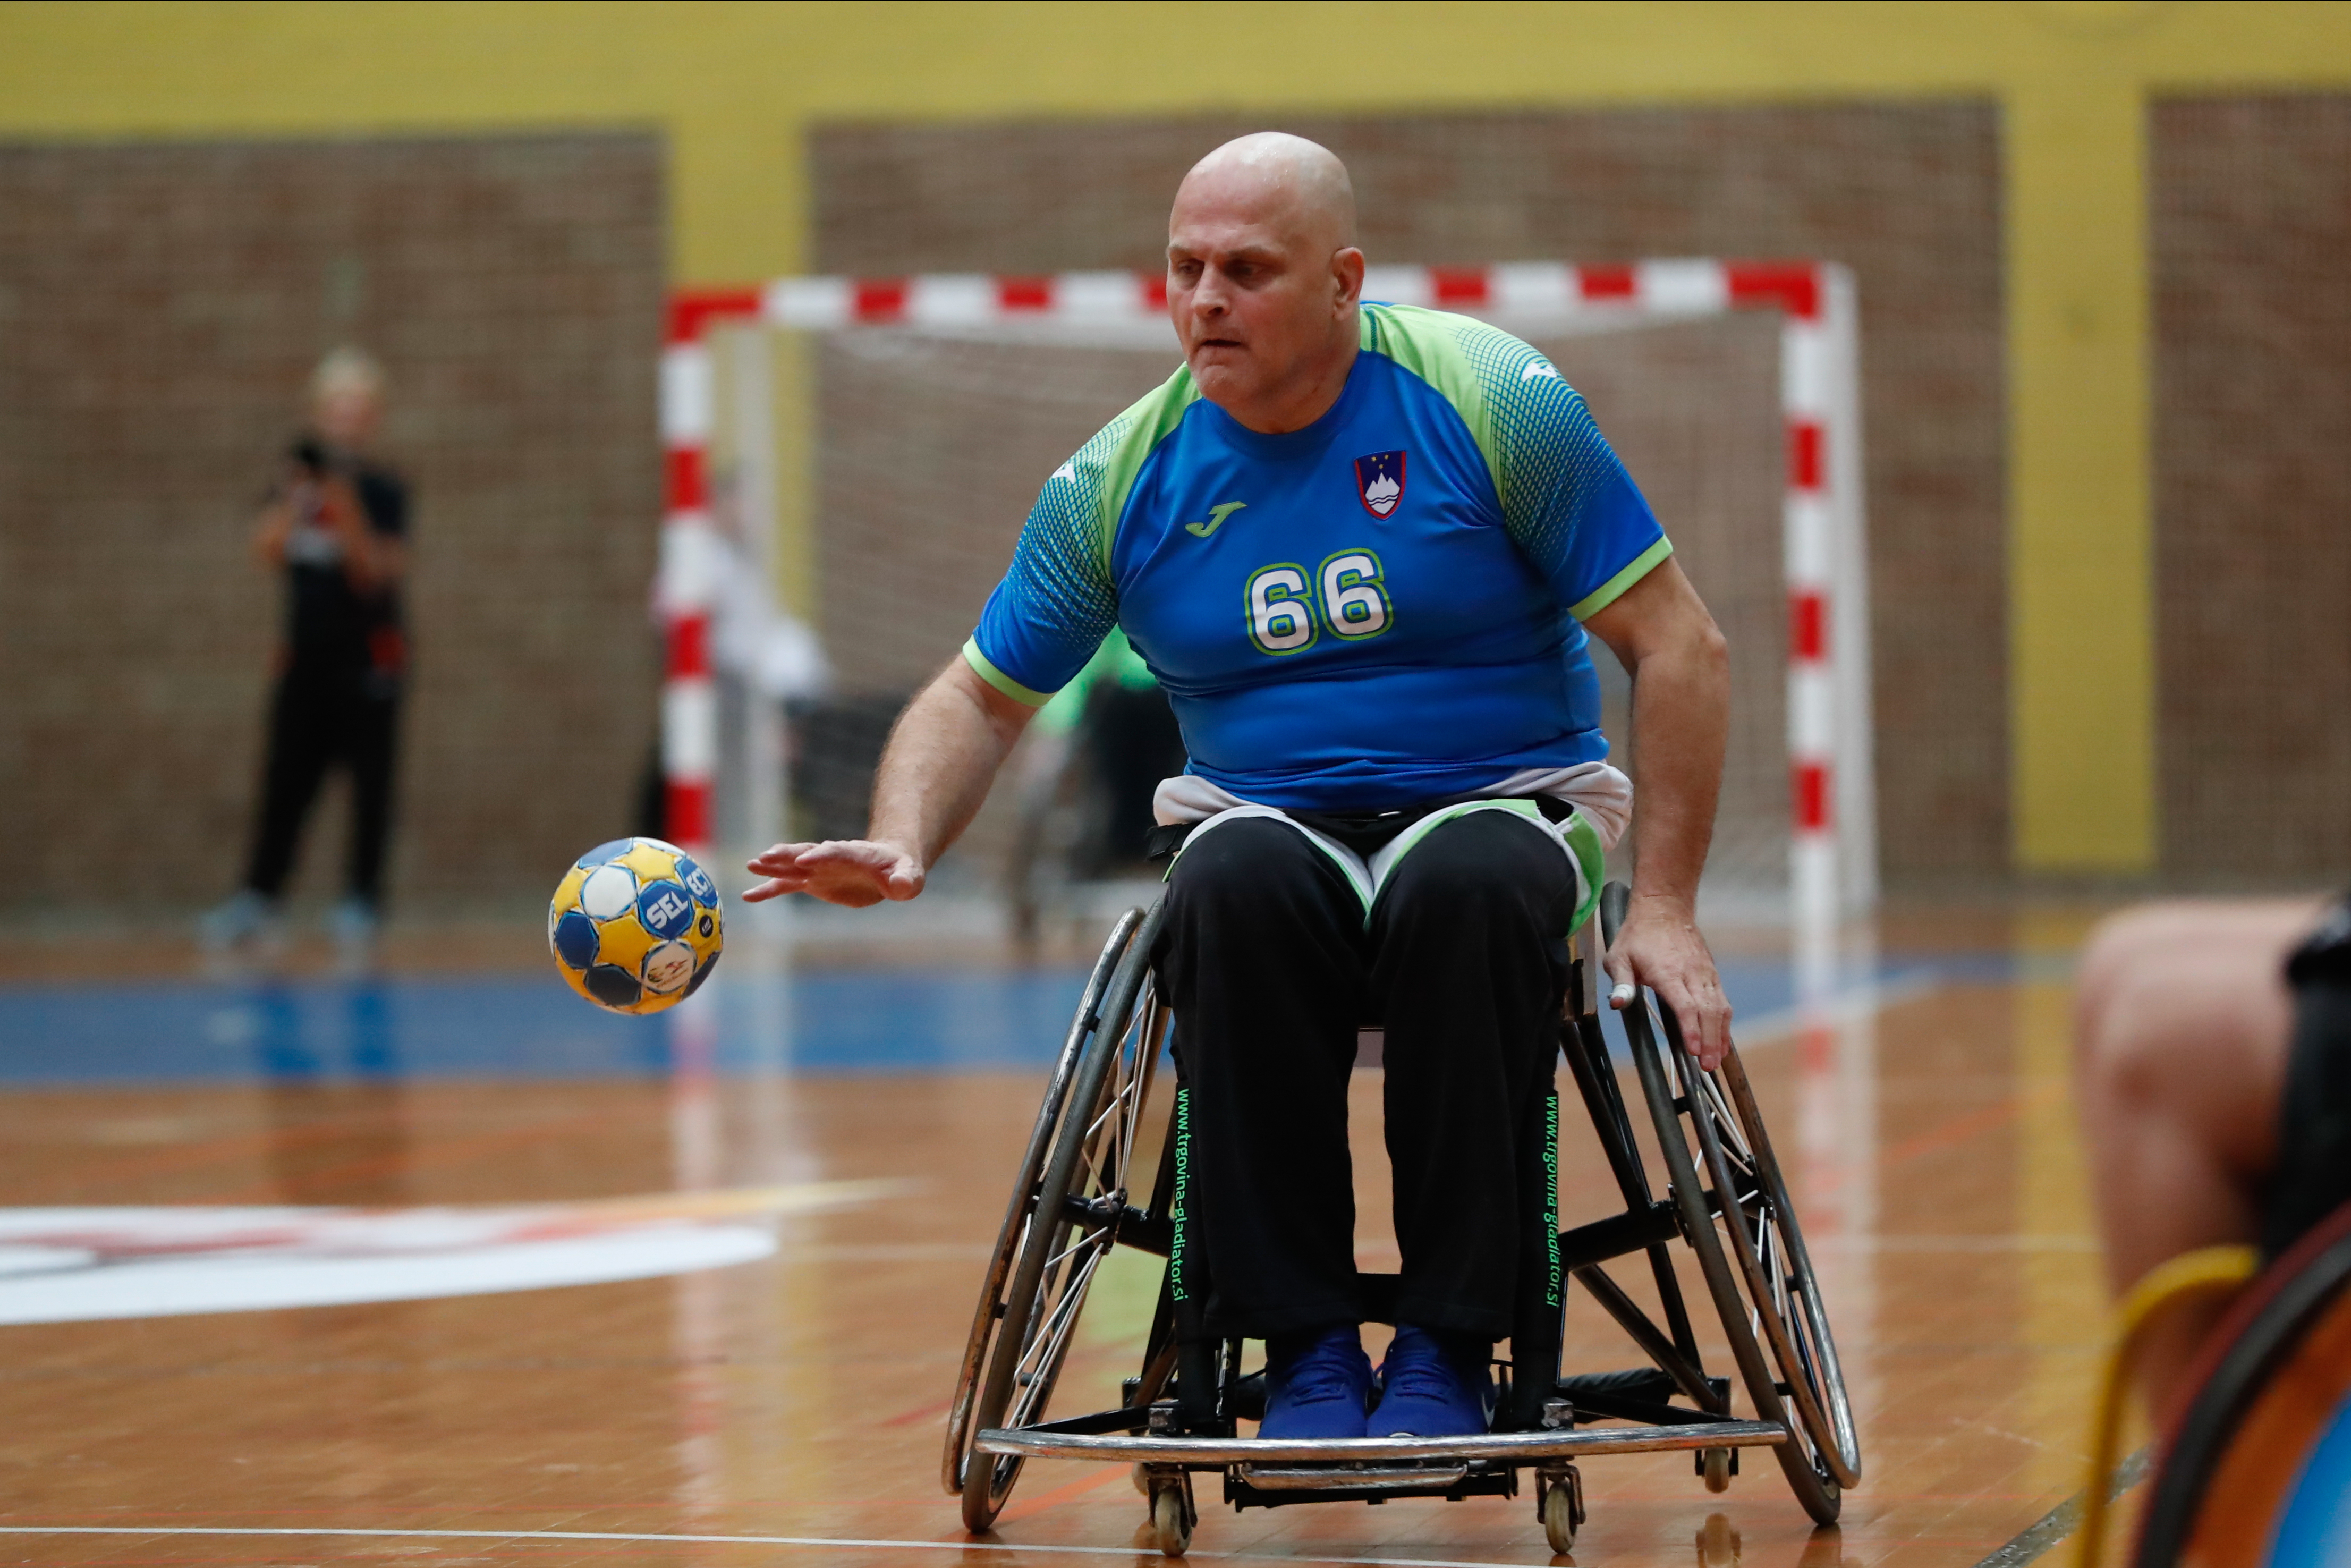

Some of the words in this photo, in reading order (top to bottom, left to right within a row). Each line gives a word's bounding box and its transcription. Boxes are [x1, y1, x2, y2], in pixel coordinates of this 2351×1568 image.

[1244, 548, 1393, 655] 66
[1172, 1089, 1191, 1301] www.trgovina-gladiator.si
[1543, 1096, 1560, 1308] www.trgovina-gladiator.si
